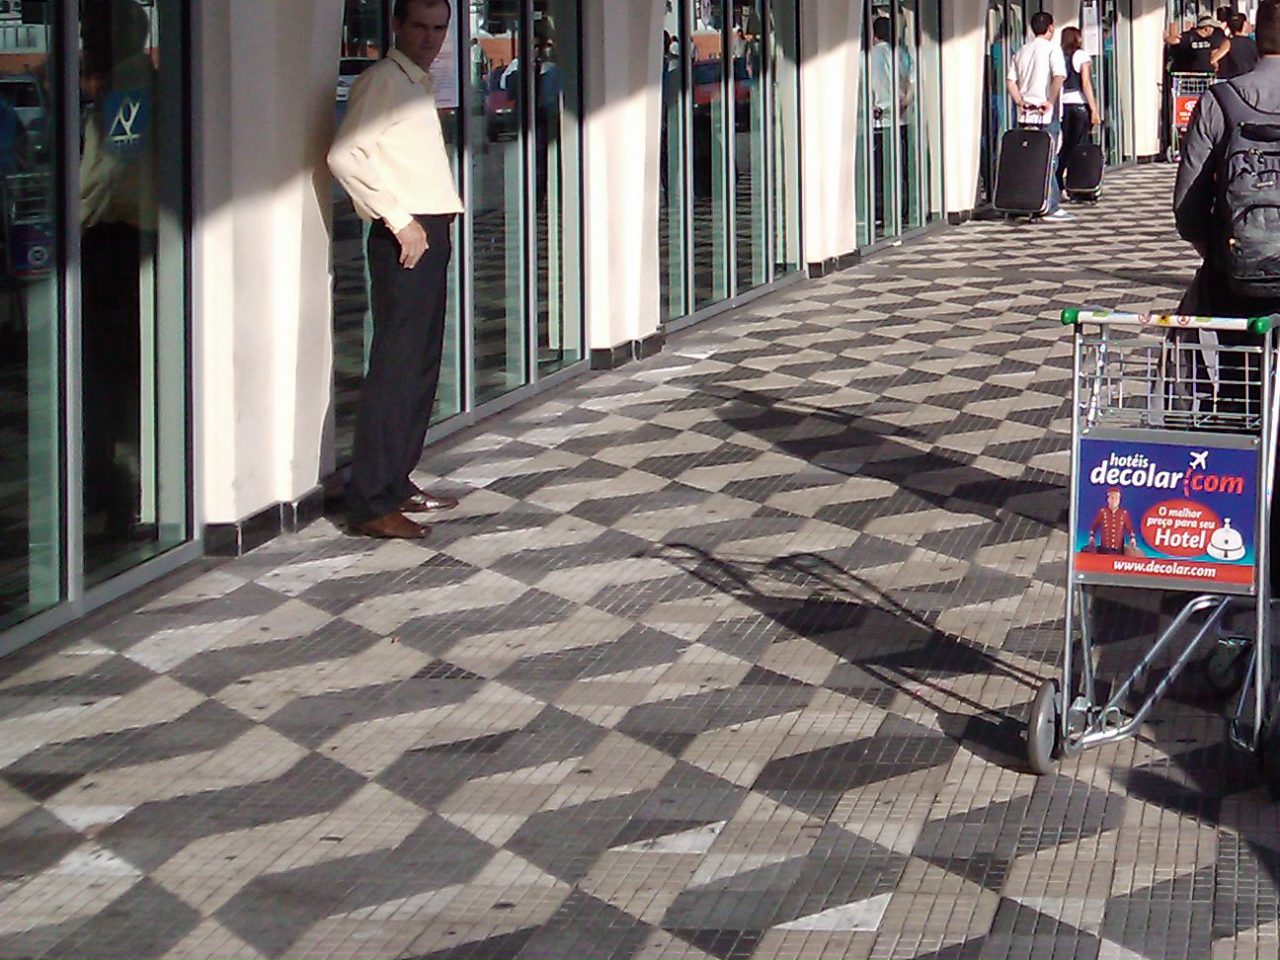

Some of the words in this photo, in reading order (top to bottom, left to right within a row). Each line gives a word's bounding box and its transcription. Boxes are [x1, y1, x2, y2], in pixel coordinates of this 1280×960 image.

[1109, 452, 1149, 468] hotéis
[1158, 506, 1167, 517] O
[1168, 508, 1202, 519] melhor
[1146, 517, 1173, 529] preço
[1174, 519, 1198, 529] para
[1199, 521, 1216, 529] seu
[1154, 528, 1207, 549] Hotel
[1113, 560, 1217, 577] www.decolar.com
